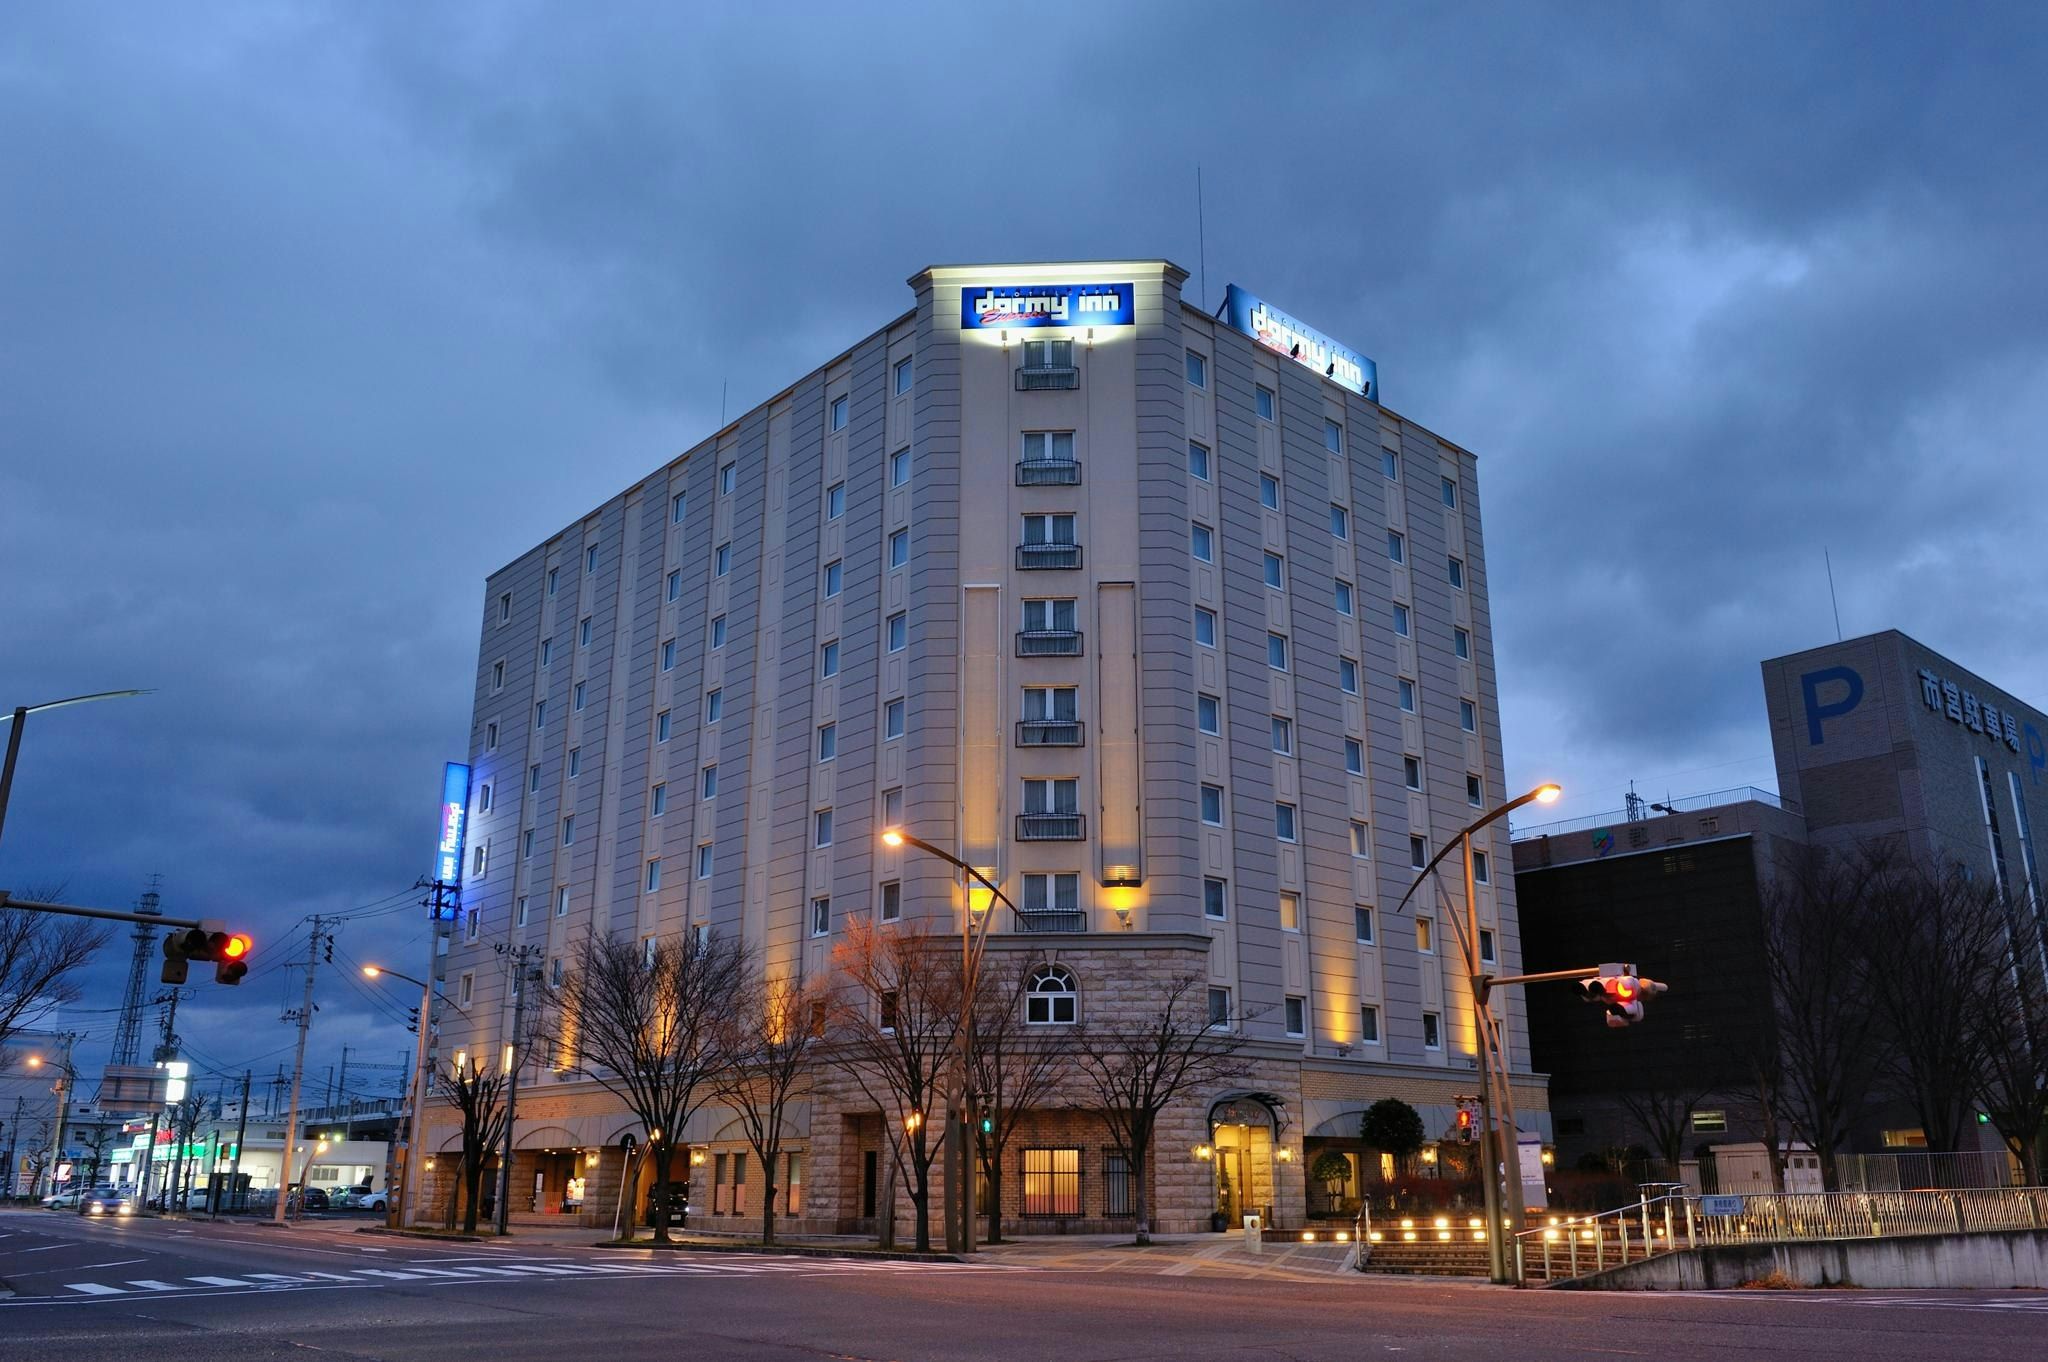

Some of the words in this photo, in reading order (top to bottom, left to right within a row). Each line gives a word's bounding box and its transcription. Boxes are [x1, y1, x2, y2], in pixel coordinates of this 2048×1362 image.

[975, 290, 1069, 320] dormy
[1078, 295, 1119, 312] inn
[1251, 303, 1326, 377] dormy
[1331, 352, 1361, 387] inn
[1801, 666, 1864, 745] P
[1918, 667, 2021, 753] 市営駐車場
[2023, 720, 2046, 786] P
